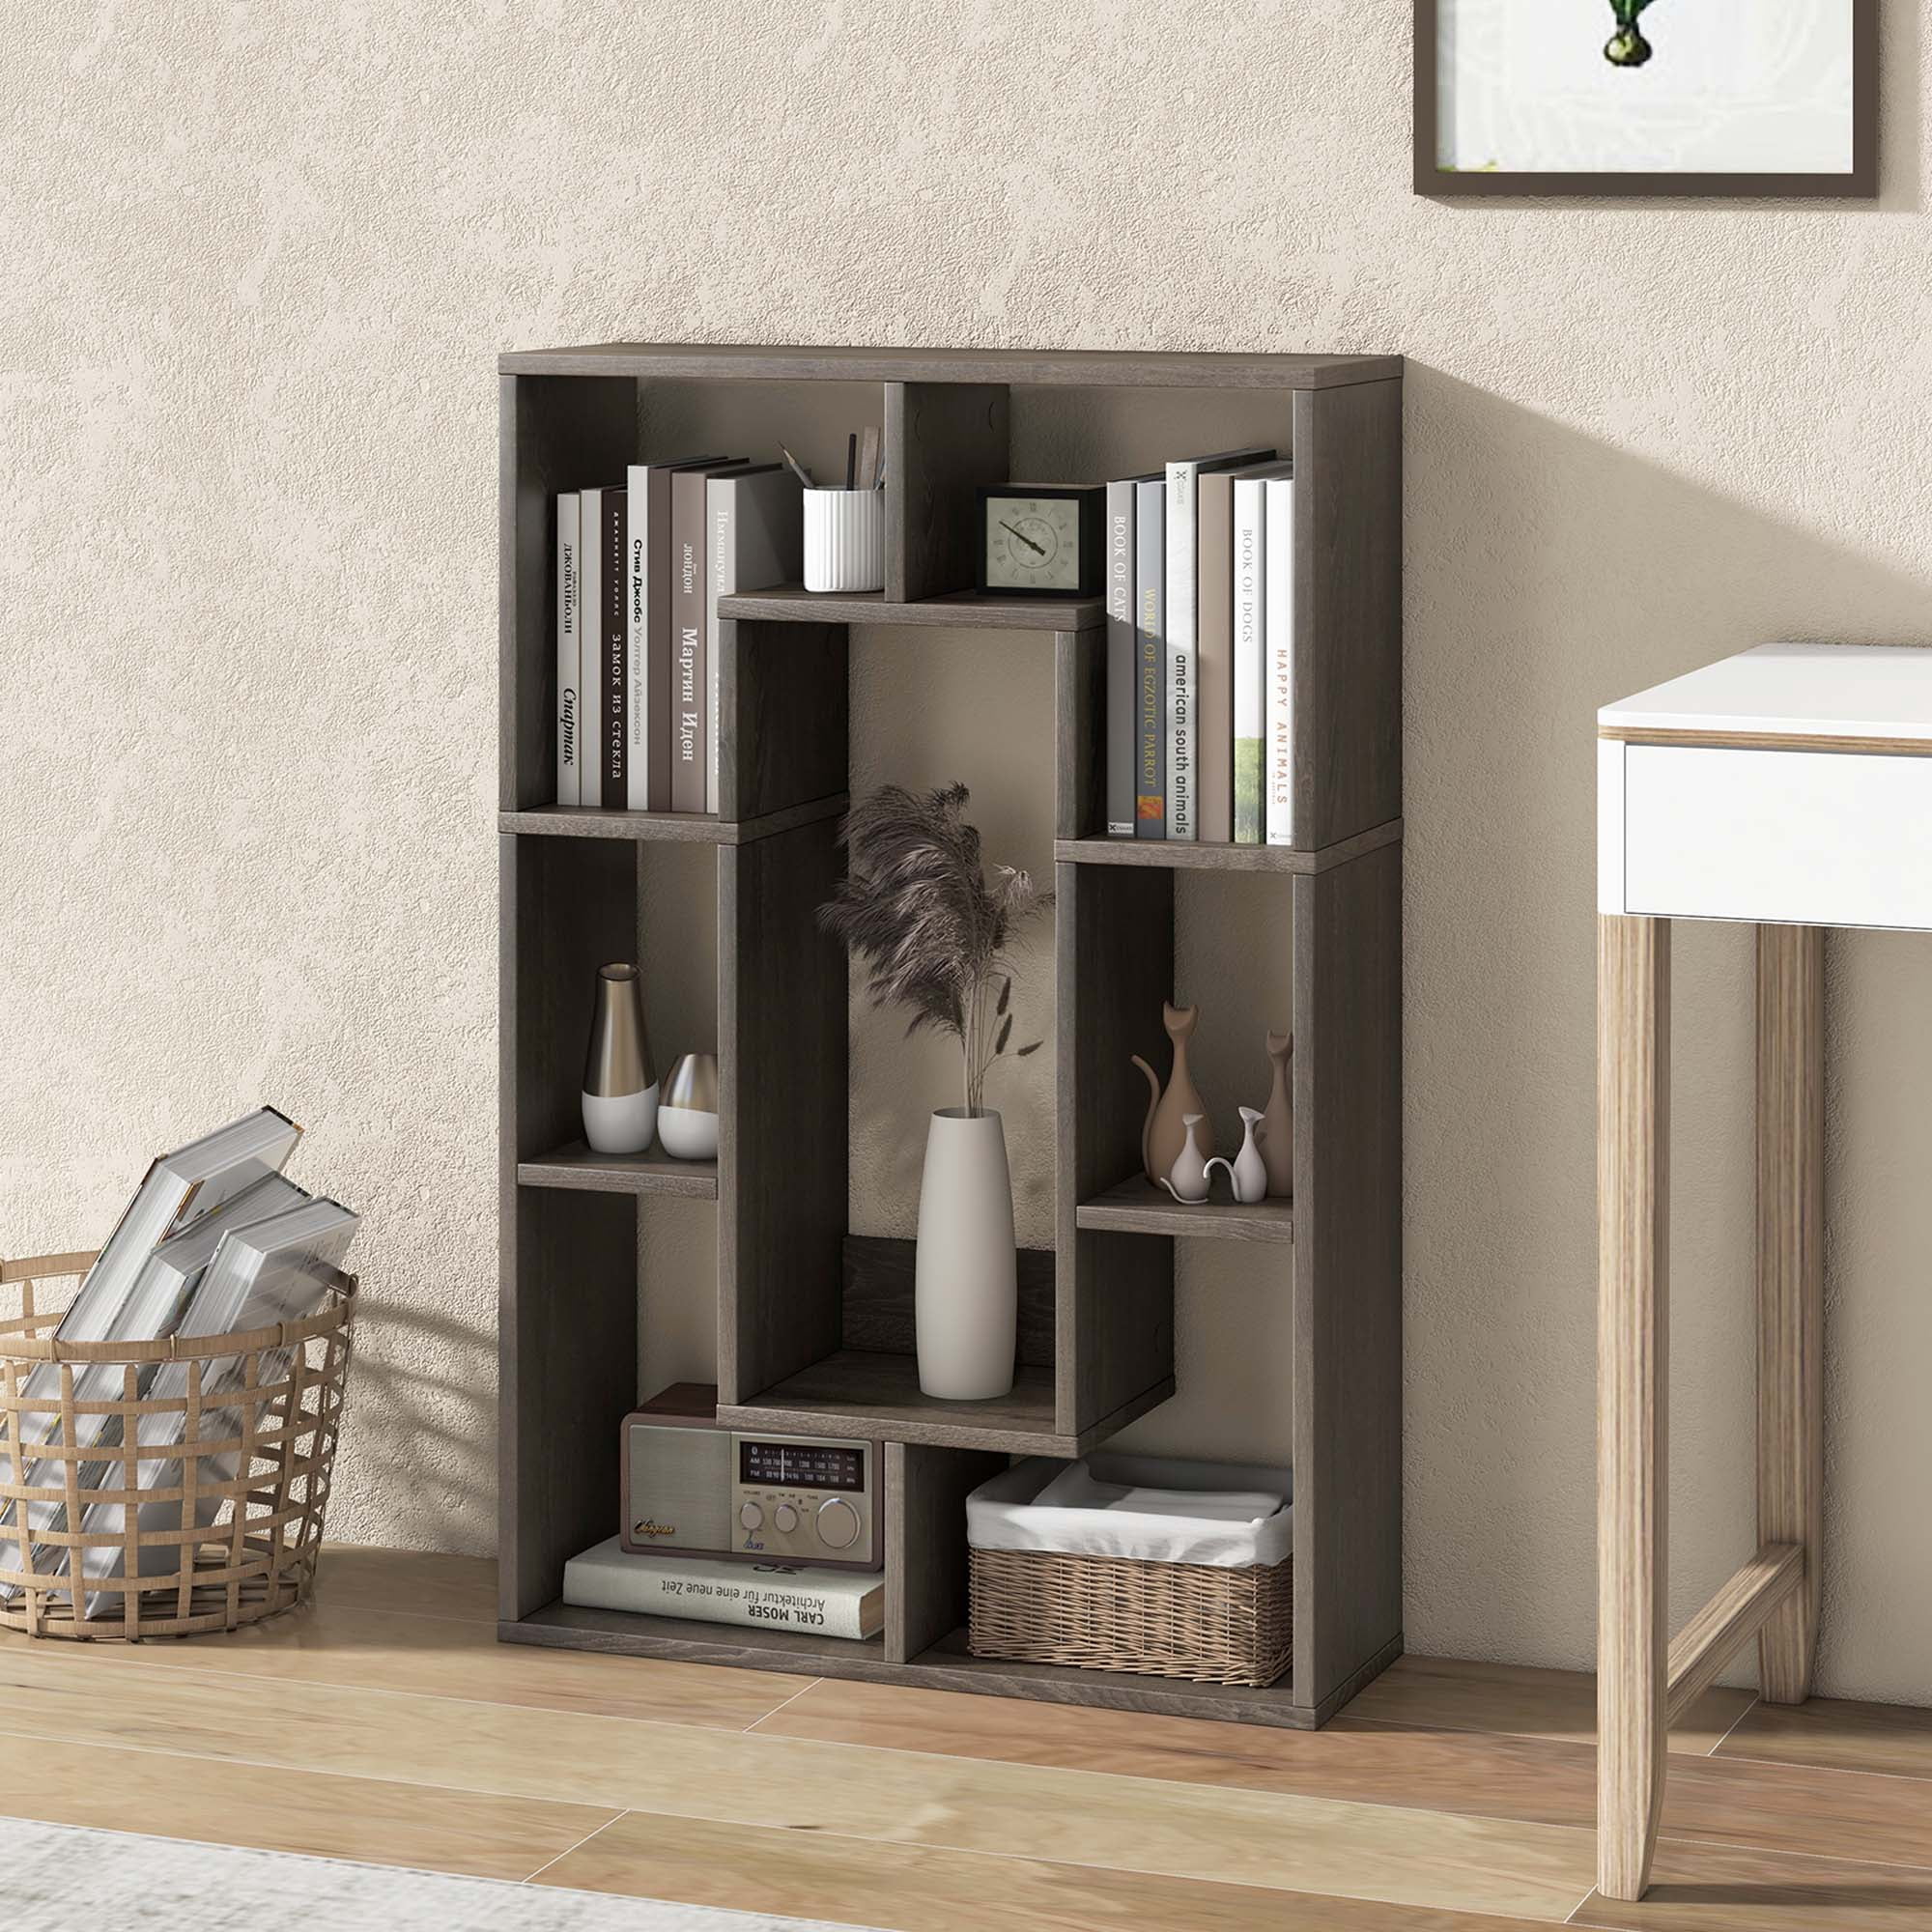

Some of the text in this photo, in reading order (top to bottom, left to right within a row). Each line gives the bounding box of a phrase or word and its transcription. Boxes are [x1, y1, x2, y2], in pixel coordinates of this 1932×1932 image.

[563, 543, 573, 635] ДЖОВАНЬОЛИ
[1114, 515, 1127, 623] BOOK OF CATS
[1241, 527, 1253, 643] BOOK OF DOGS
[631, 538, 644, 746] Стив Джобс Уолтер Айзексон
[679, 627, 697, 761] Мартин Иден
[1144, 587, 1156, 787] WORLD OF EGZOTIC PARROT
[559, 687, 577, 766] Спартак
[611, 633, 622, 780] замок из стекла
[1175, 654, 1188, 835] american south animals
[1276, 649, 1288, 805] HAPPY ANIMALS
[661, 1580, 826, 1612] Architektur für eine neue Zeit
[748, 1605, 825, 1626] CARL MOSER
